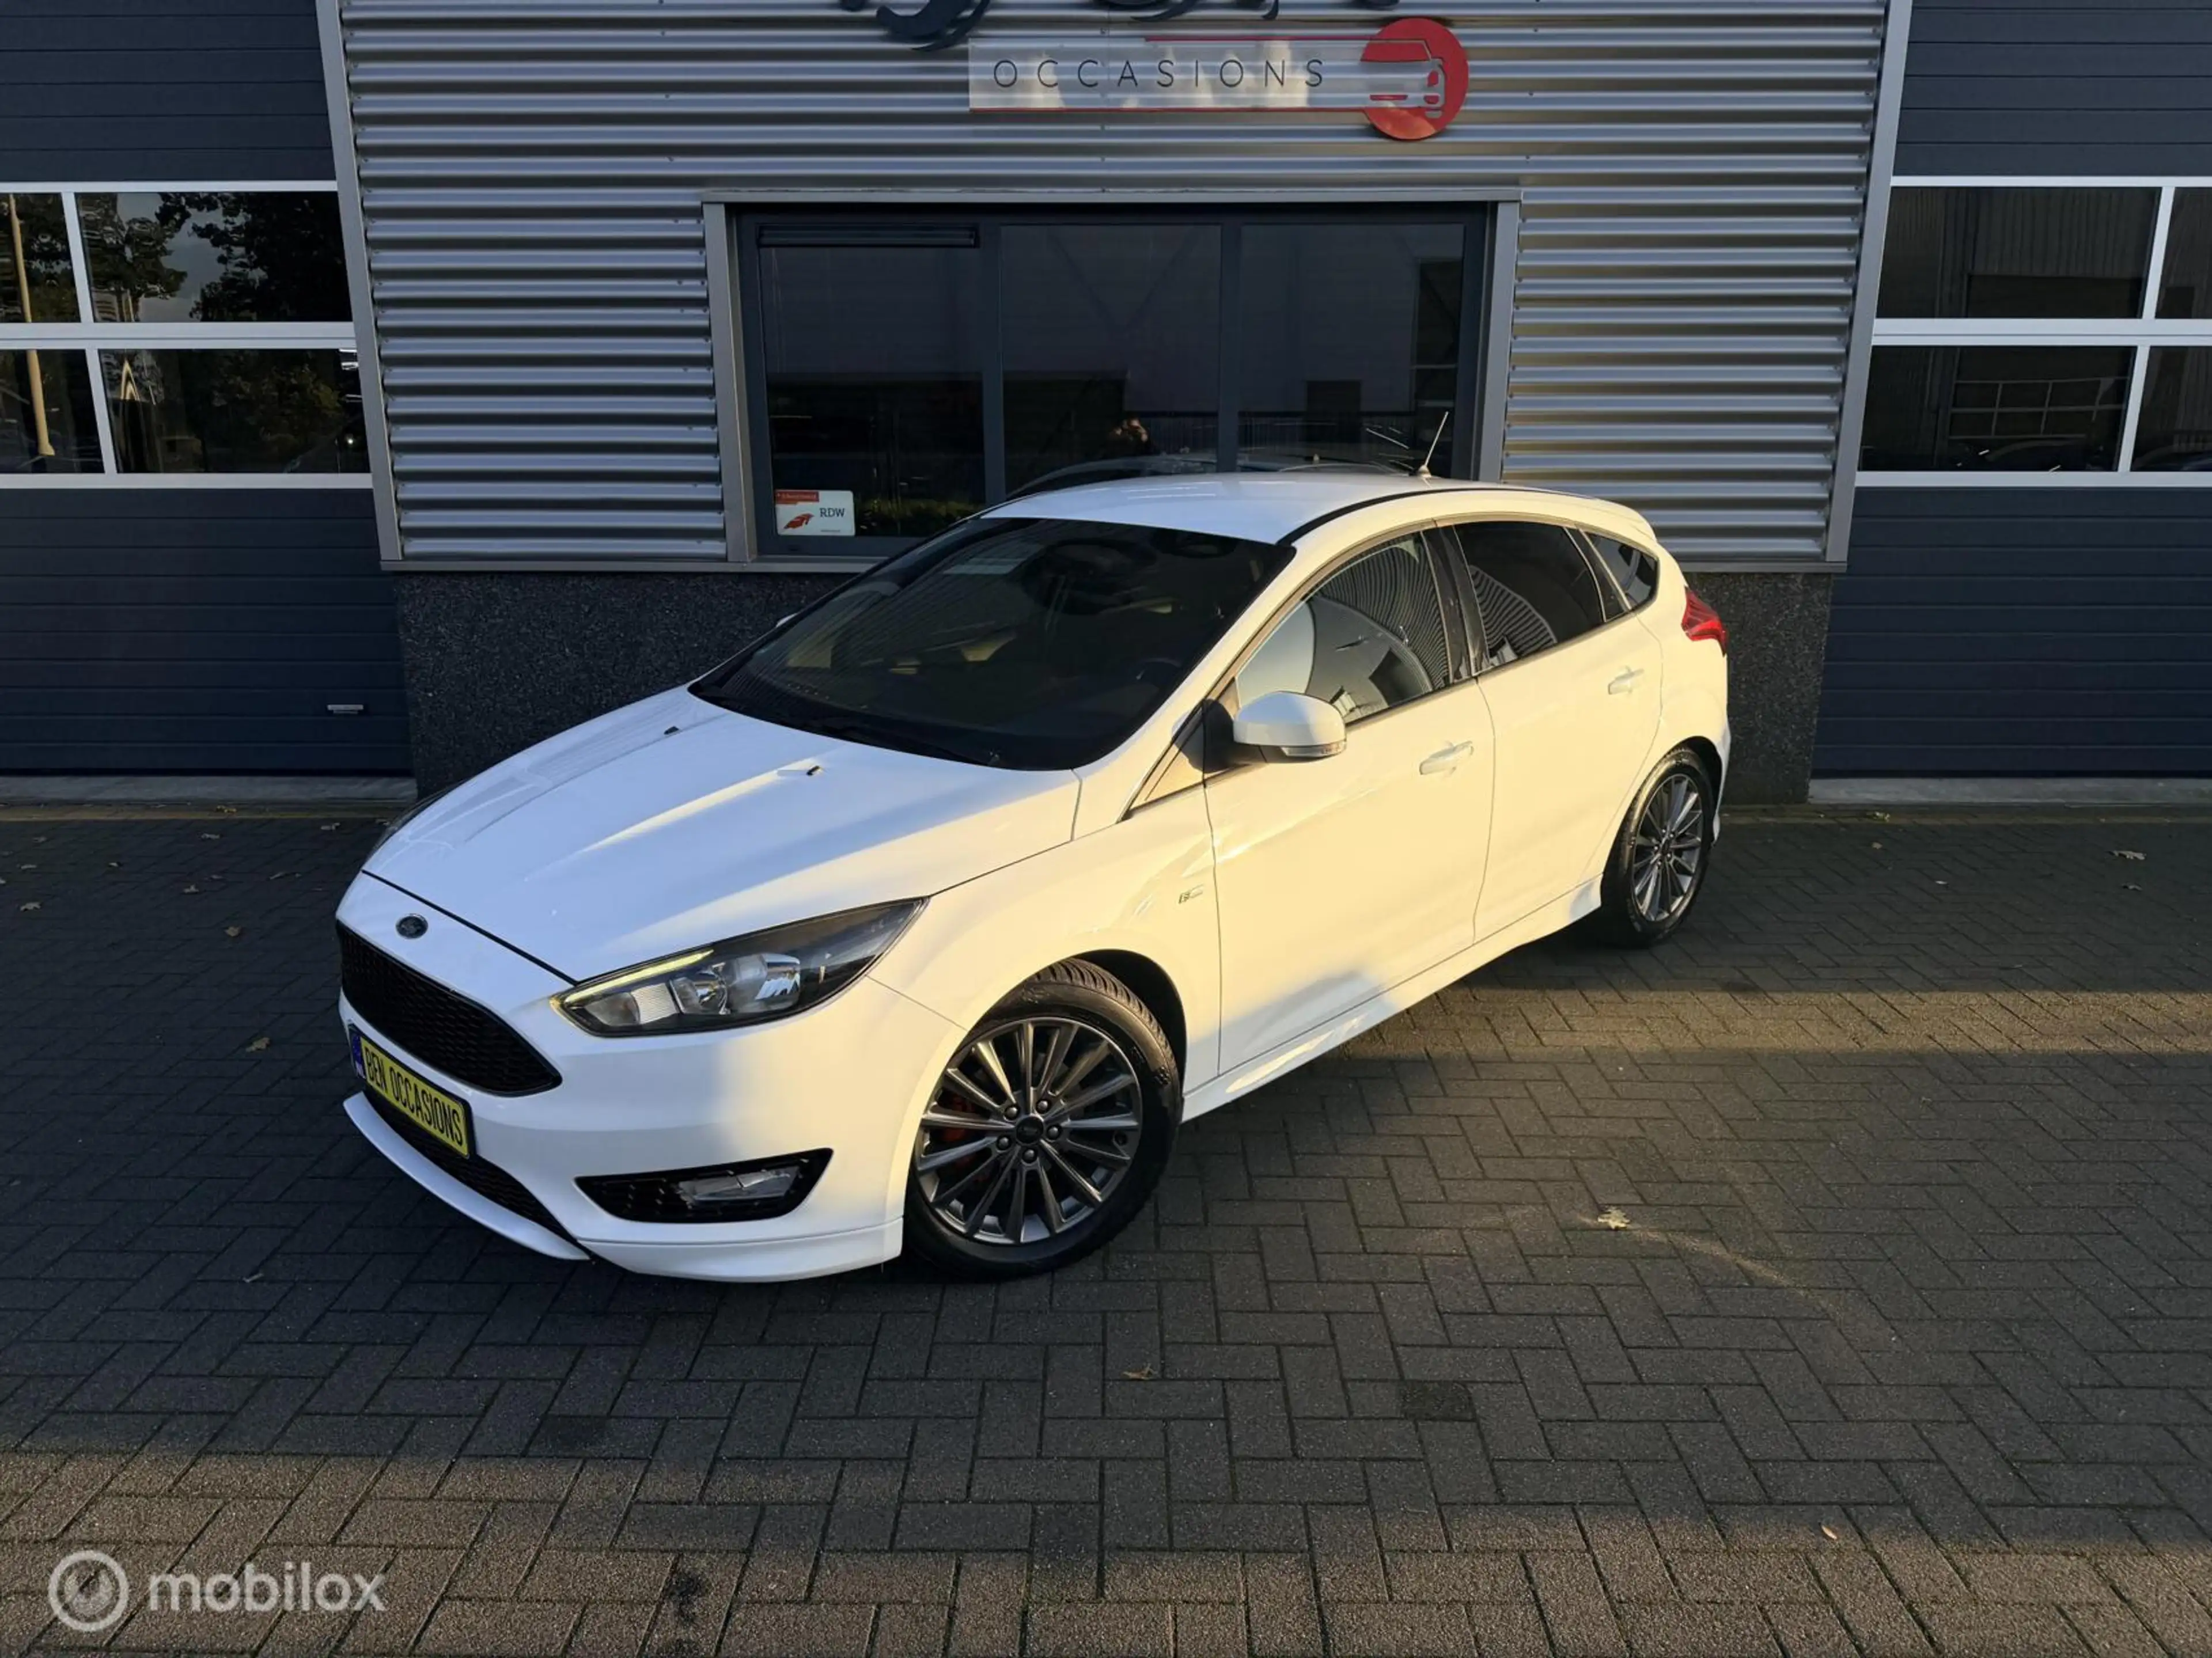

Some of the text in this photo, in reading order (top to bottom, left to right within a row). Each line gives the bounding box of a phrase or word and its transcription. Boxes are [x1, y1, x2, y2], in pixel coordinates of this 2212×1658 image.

[993, 59, 1323, 88] OCCASIONS
[820, 507, 845, 518] RDW
[389, 1067, 463, 1146] OCCASIONS
